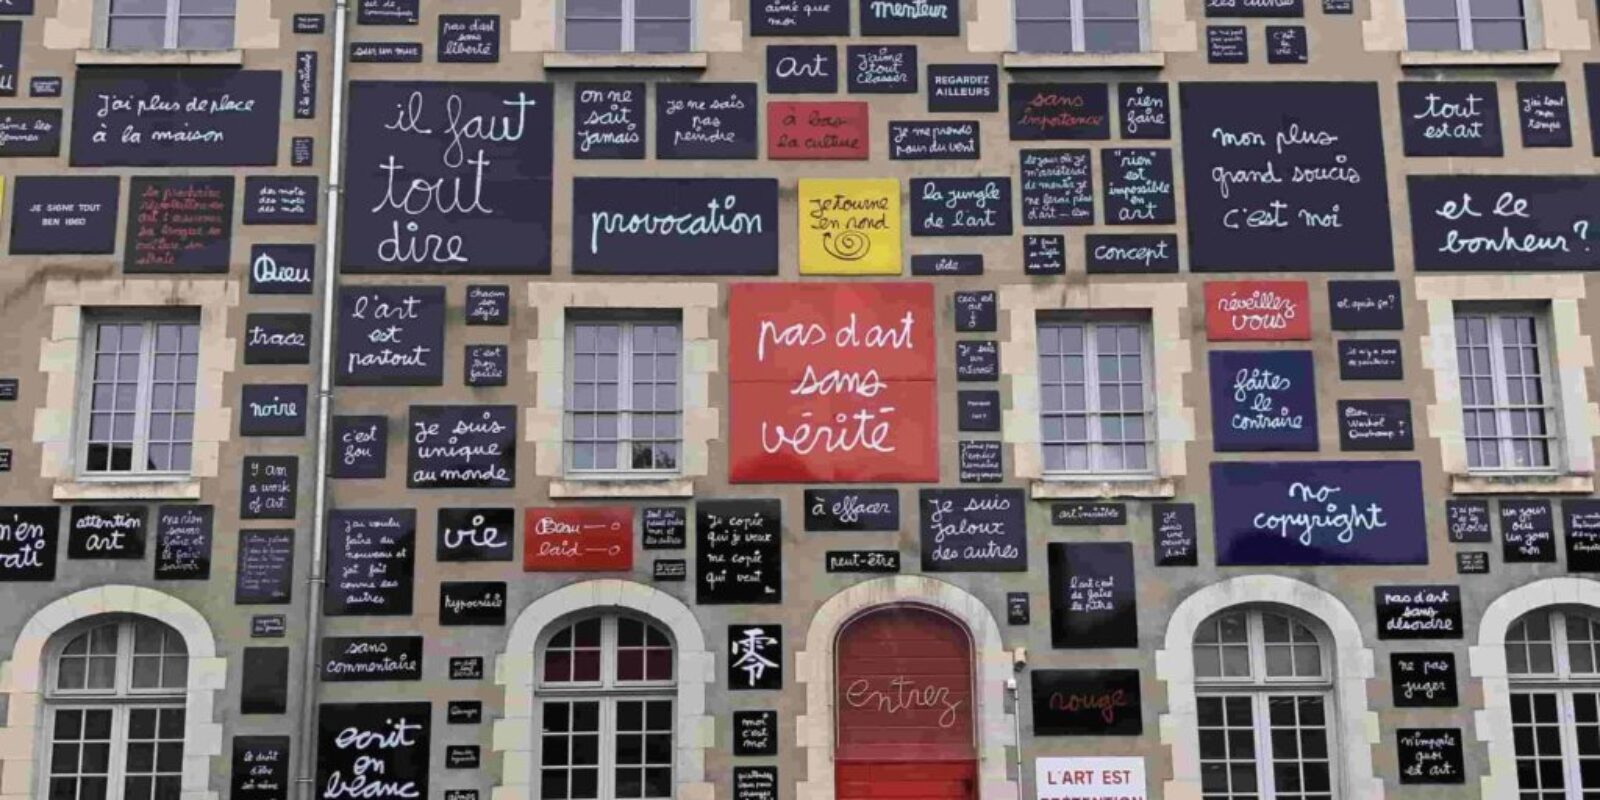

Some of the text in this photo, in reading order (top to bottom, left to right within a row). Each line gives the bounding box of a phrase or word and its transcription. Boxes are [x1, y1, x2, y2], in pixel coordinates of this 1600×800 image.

[444, 23, 465, 34] pas
[775, 54, 828, 78] art
[866, 63, 899, 73] tout
[935, 76, 990, 85] REGARDEZ
[580, 89, 632, 102] on ne
[710, 94, 745, 110] sais
[935, 88, 990, 96] AILLEURS
[1030, 92, 1084, 108] sans
[1126, 86, 1164, 108] rien
[138, 95, 181, 116] plus
[185, 97, 206, 112] de
[210, 94, 255, 113] place
[584, 103, 631, 126] sait
[1414, 93, 1484, 119] tout
[692, 116, 721, 128] pas
[1017, 107, 1103, 130] importance
[1127, 108, 1166, 134] faire
[93, 123, 224, 144] à la maison
[385, 91, 535, 168] il faut
[578, 122, 639, 152] jamais
[674, 126, 736, 146] peindre
[1212, 123, 1338, 154] mon plus
[1423, 122, 1483, 138] est art
[777, 135, 859, 149] la culture
[929, 142, 947, 153] du
[948, 138, 975, 152] vent
[371, 149, 493, 215] tout
[1212, 155, 1360, 199] grand soucis
[922, 181, 1000, 208] la jungle
[1109, 180, 1170, 200] impossible
[78, 204, 101, 212] TOUT
[1118, 203, 1157, 221] art
[1223, 200, 1343, 228] c'est moi
[1435, 192, 1530, 220] et le
[42, 218, 60, 226] BEN
[591, 195, 763, 254] provocation
[846, 215, 889, 230] rond
[924, 212, 945, 229] de
[378, 220, 468, 262] dire
[1094, 240, 1169, 266] concept
[254, 252, 310, 283] Dieu
[352, 294, 421, 319] l'art
[1232, 314, 1287, 330] vous
[249, 326, 305, 346] trace
[368, 325, 403, 343] est
[758, 320, 827, 361] pas
[348, 345, 431, 373] partout
[790, 365, 888, 395] sans
[1234, 368, 1291, 402] faites
[250, 396, 297, 418] noire
[1250, 393, 1272, 412] le
[453, 411, 506, 434] suis
[1231, 407, 1303, 430] contraire
[762, 407, 896, 454] vérité
[344, 446, 372, 465] fou
[418, 436, 502, 463] unique
[414, 464, 511, 482] au monde
[261, 480, 290, 492] work
[1288, 482, 1340, 503] no
[812, 495, 891, 523] à effacer
[963, 494, 1011, 513] suis
[76, 514, 141, 528] attention
[729, 512, 763, 530] copie
[931, 519, 1006, 543] jaloux
[1253, 502, 1387, 545] copyright
[85, 530, 125, 551] art
[444, 514, 508, 549] vie
[537, 541, 583, 556] laid
[732, 550, 762, 567] copie
[932, 541, 1018, 561] des autres
[830, 553, 896, 569] peut-être
[706, 569, 727, 591] qui
[1385, 594, 1411, 605] pas
[1402, 607, 1438, 617] sans
[1387, 617, 1453, 631] désordre
[345, 641, 387, 654] sans
[327, 654, 417, 673] commentaire
[1424, 662, 1448, 674] pas
[1402, 682, 1447, 699] juger
[847, 677, 964, 727] entrez
[1050, 689, 1129, 723] rouge
[323, 770, 420, 799] blanc
[1047, 770, 1131, 785] L'ART EST
